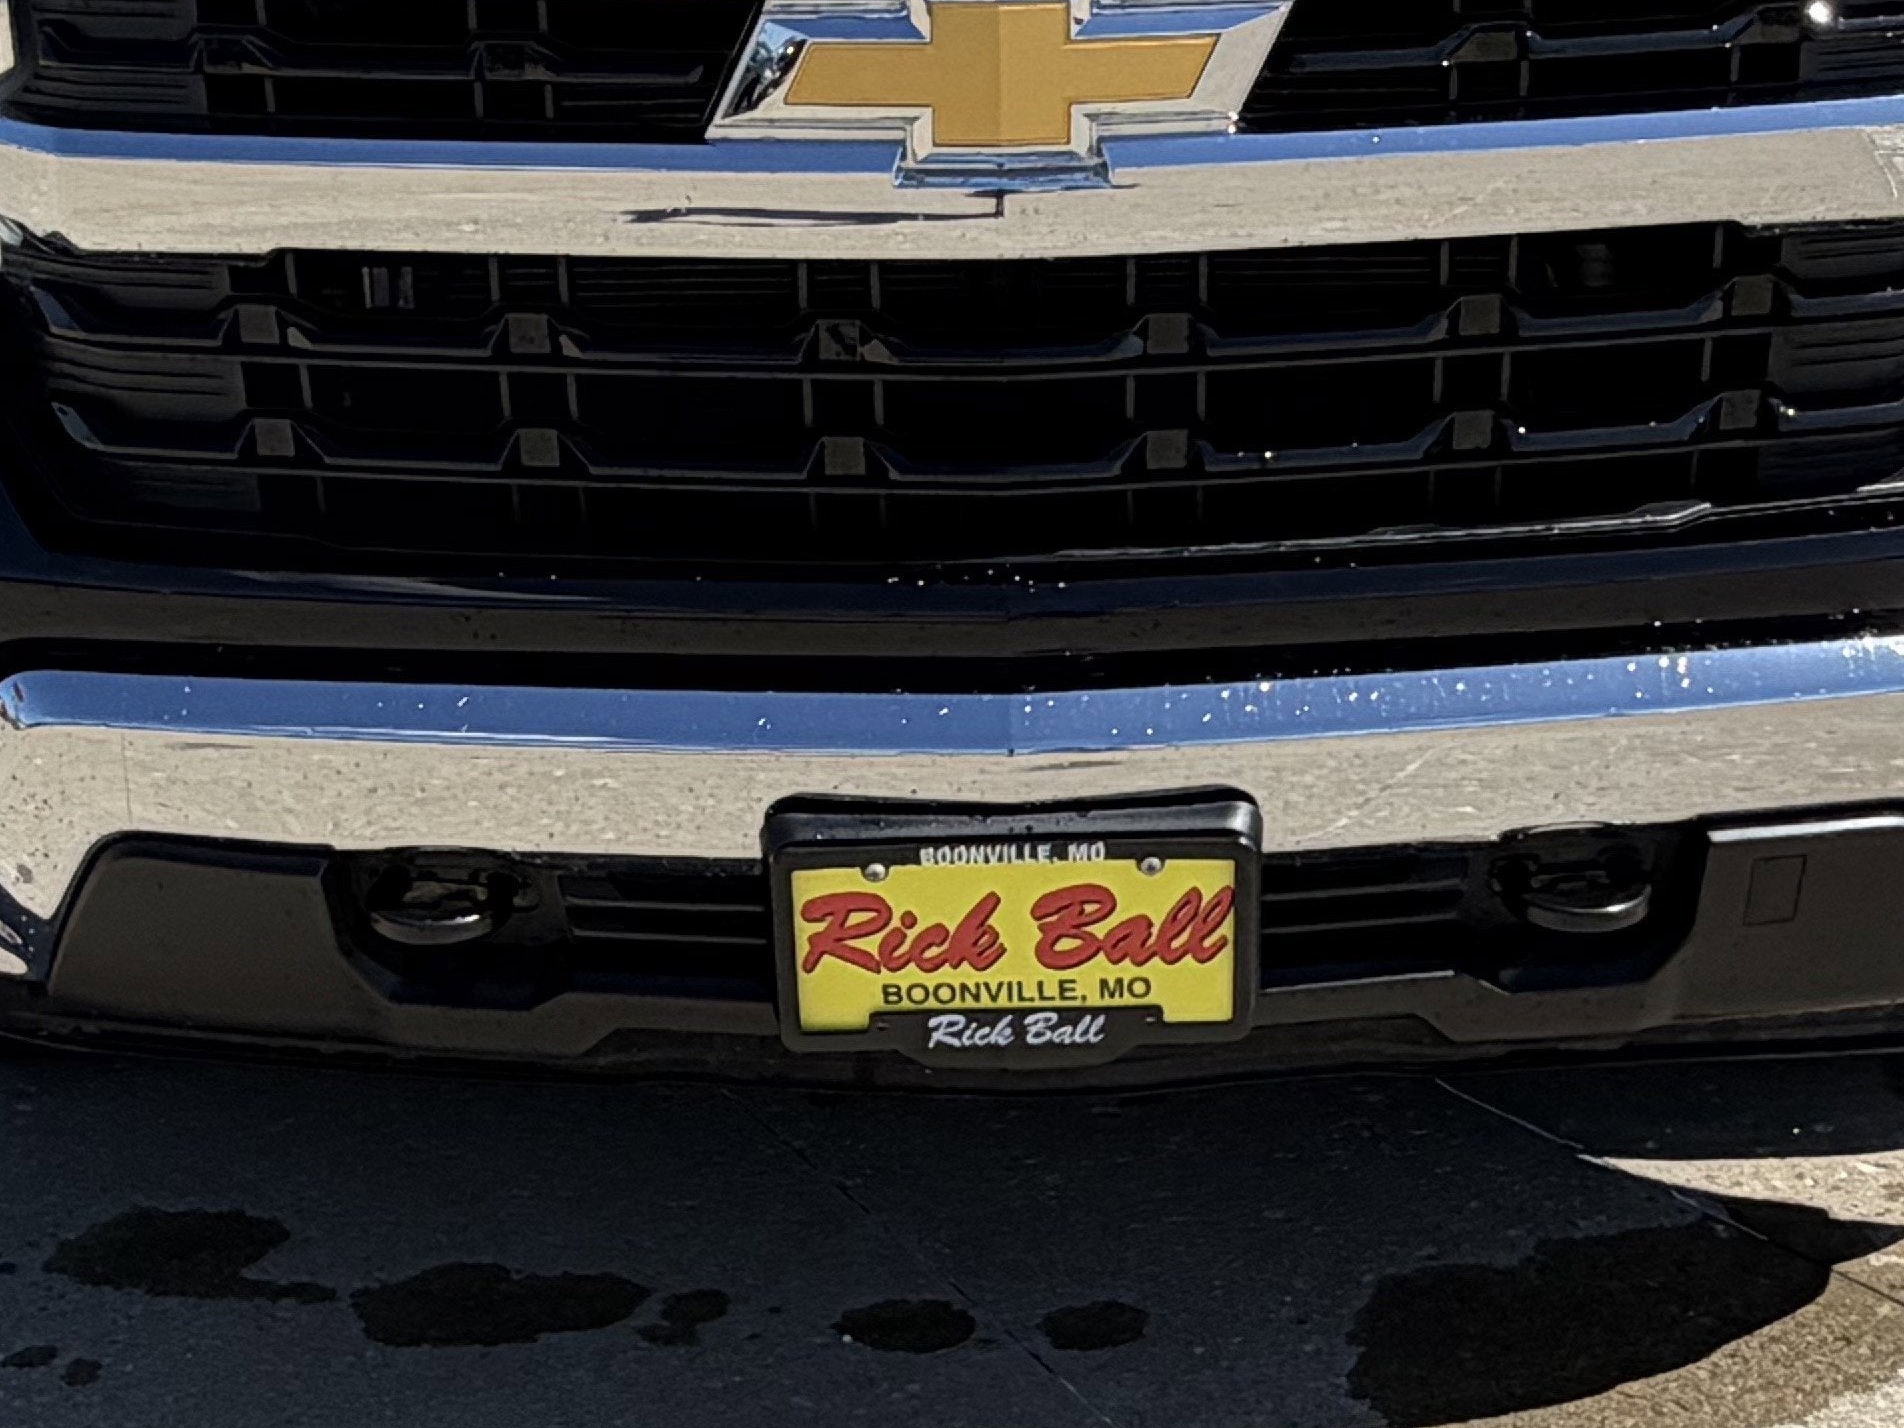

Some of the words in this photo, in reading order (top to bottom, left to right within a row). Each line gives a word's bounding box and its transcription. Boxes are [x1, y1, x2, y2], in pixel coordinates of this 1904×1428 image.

[919, 842, 1058, 865] BOONVILLE,
[1068, 841, 1106, 863] MO
[800, 890, 1007, 975] Rick
[1029, 883, 1236, 971] Ball
[881, 978, 1088, 1006] BOONVILLE,
[1098, 976, 1152, 1001] MO
[927, 1014, 1016, 1050] Rick
[1023, 1011, 1106, 1046] Ball
